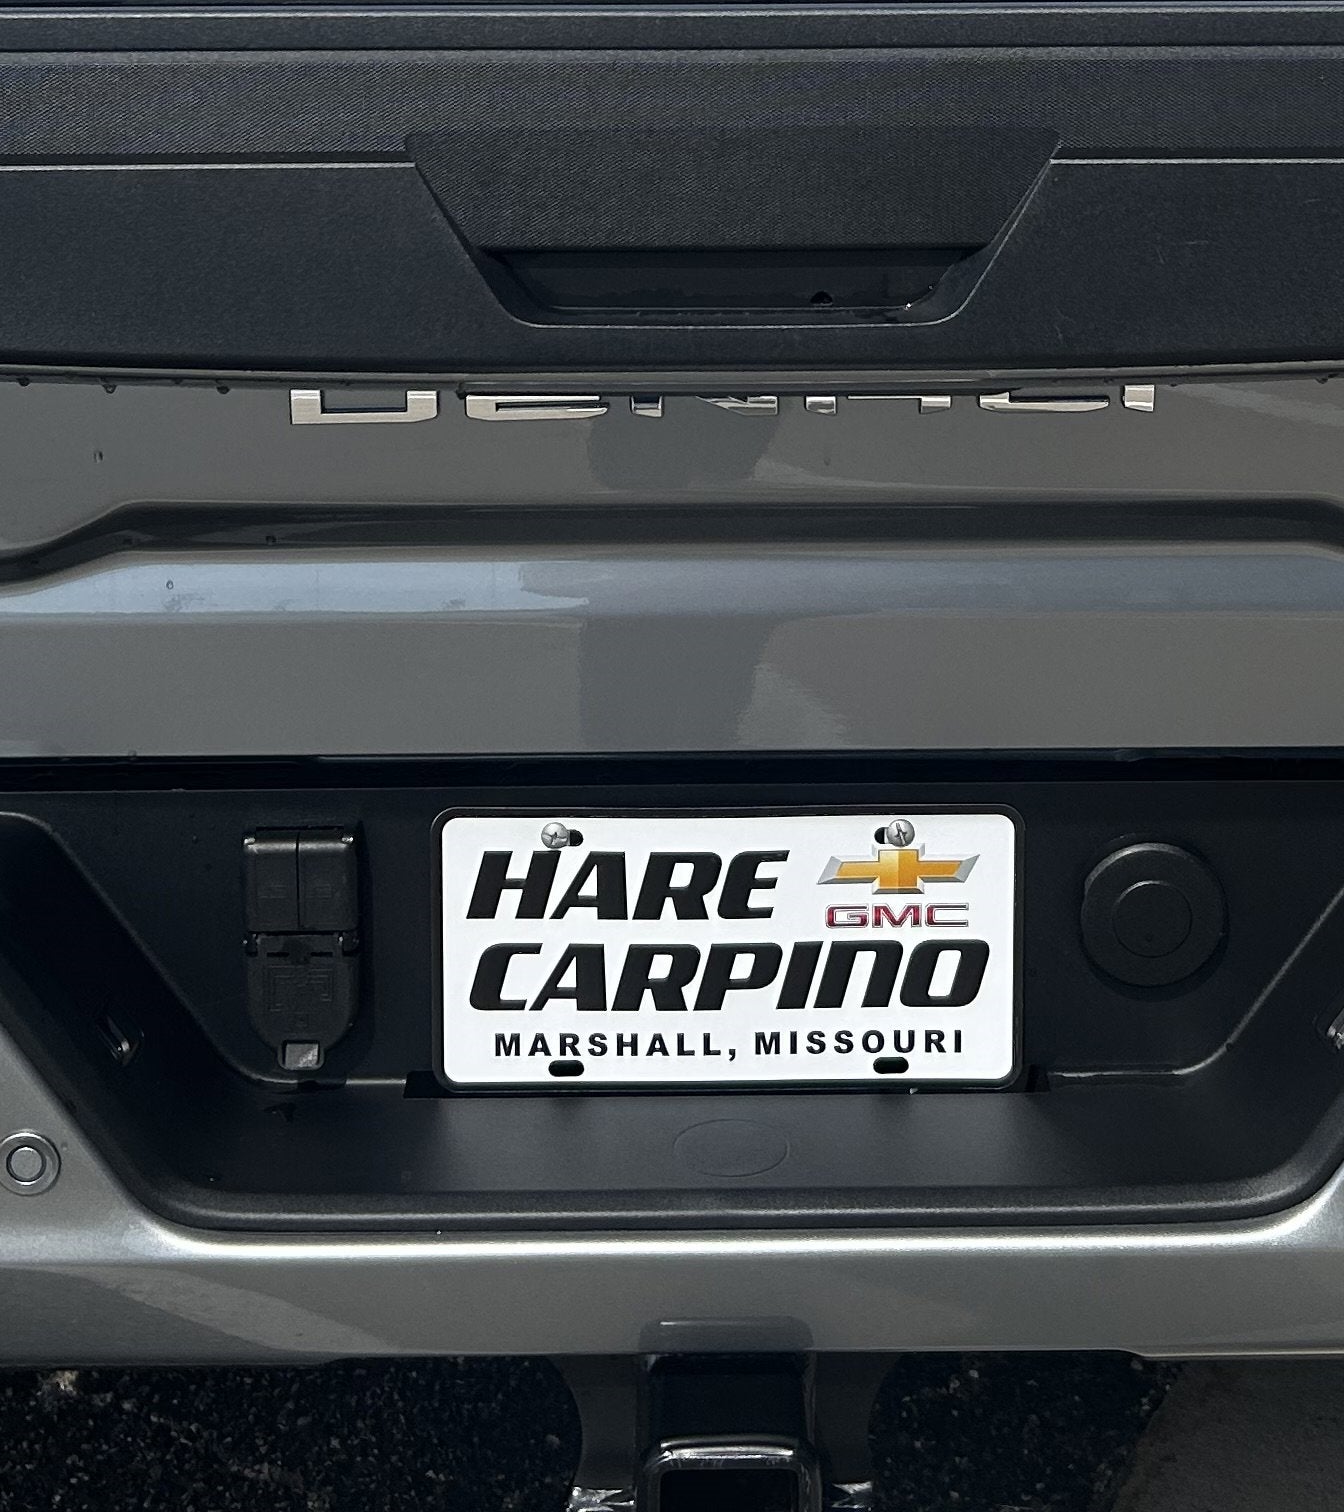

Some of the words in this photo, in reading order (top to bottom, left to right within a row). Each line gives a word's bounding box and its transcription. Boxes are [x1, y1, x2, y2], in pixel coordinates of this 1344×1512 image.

[465, 849, 791, 921] HARE
[824, 902, 970, 929] GMC
[468, 939, 991, 1012] CARPINO
[494, 1031, 737, 1062] MARSHALL,
[754, 1029, 964, 1056] MISSOURI
